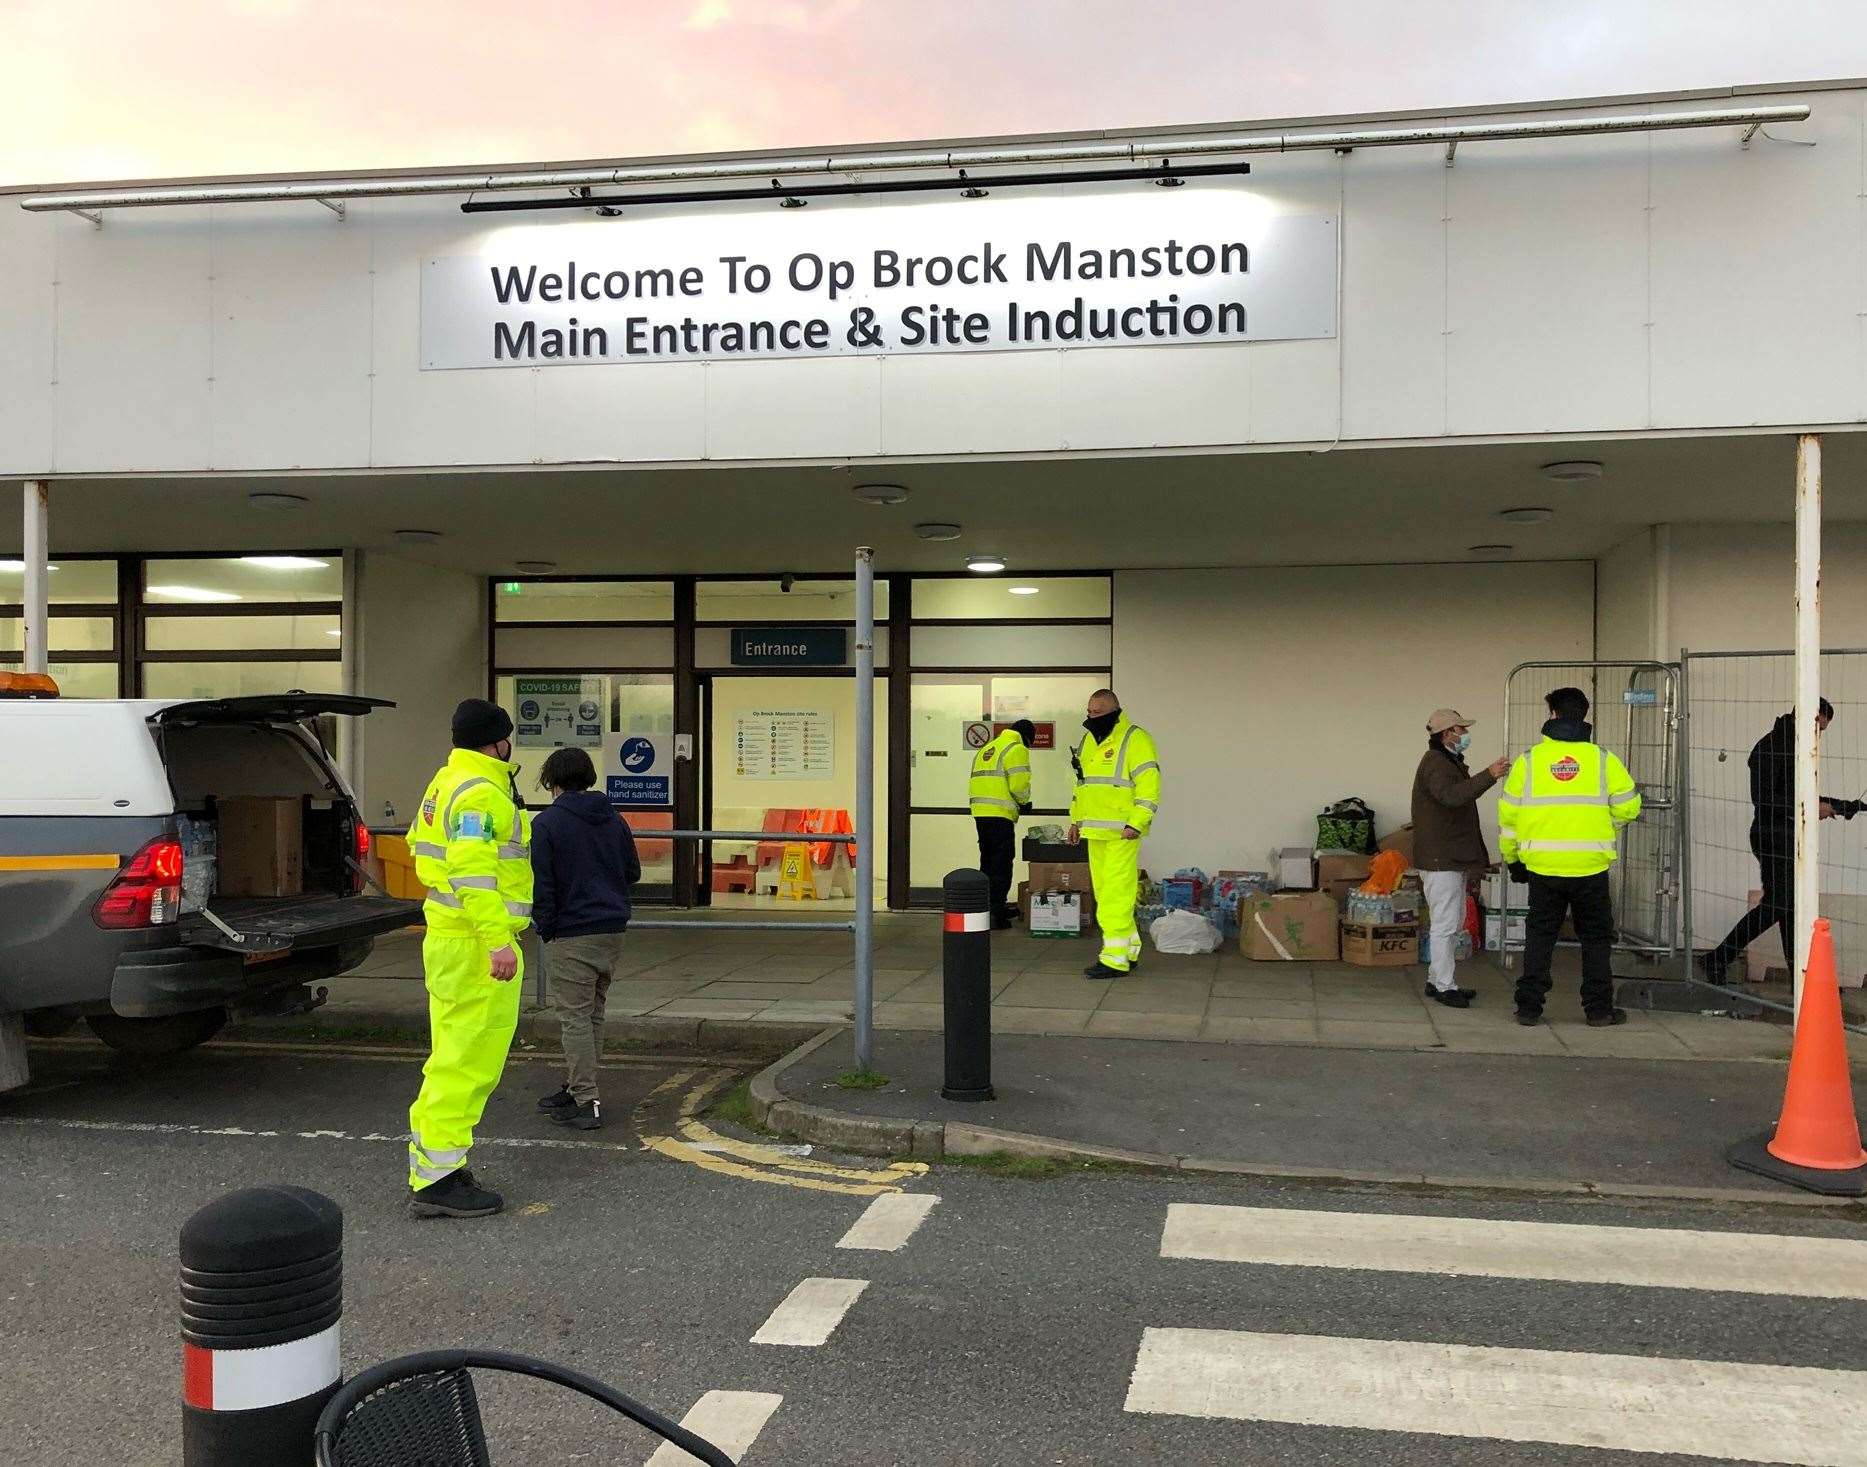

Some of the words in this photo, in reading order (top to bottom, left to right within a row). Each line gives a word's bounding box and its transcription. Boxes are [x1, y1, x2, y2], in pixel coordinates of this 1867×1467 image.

[490, 261, 705, 303] Welcome
[719, 256, 772, 294] To
[788, 253, 856, 300] Op
[873, 242, 1008, 288] Brock
[1026, 239, 1249, 283] Manston
[494, 317, 608, 359] Main
[626, 317, 830, 356] Entrance
[846, 306, 884, 348] &
[900, 303, 989, 346] Site
[1008, 294, 1246, 342] Induction
[745, 641, 808, 656] Entrance
[520, 683, 561, 692] COVID-19
[614, 779, 643, 789] Please
[608, 789, 630, 799] hand
[631, 789, 668, 799] sanitizer
[1379, 940, 1409, 952] KFC
